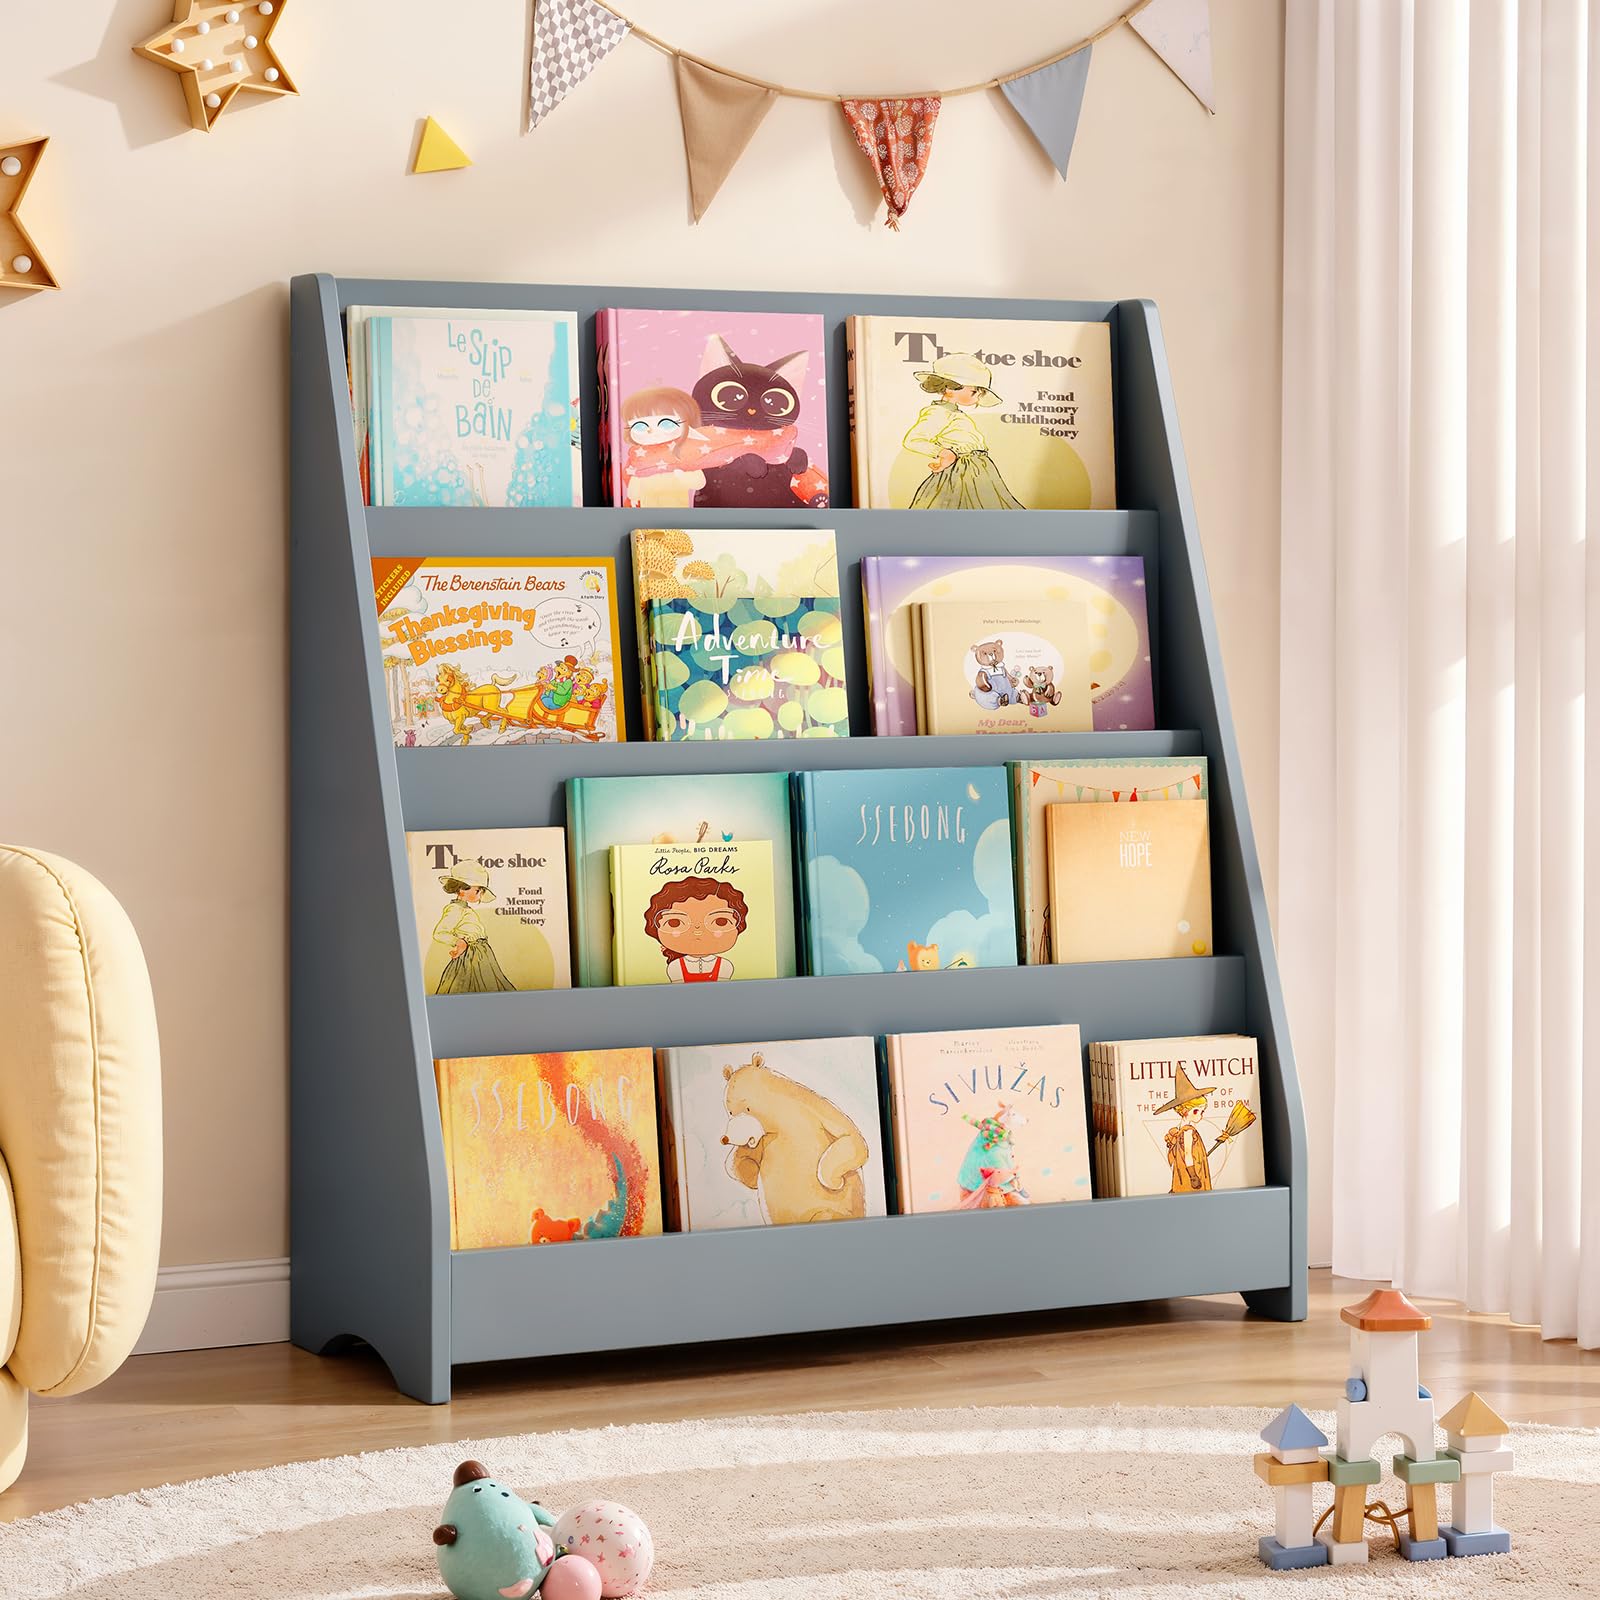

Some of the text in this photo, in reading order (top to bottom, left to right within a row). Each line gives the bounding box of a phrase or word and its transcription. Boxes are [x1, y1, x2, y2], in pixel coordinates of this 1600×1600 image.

[447, 322, 466, 352] Le
[974, 349, 1016, 367] toe
[1021, 350, 1082, 368] shoe
[1037, 391, 1075, 402] Fond
[1018, 403, 1079, 416] Memory
[1000, 414, 1075, 426] Childhood
[1039, 427, 1079, 440] Story
[375, 564, 403, 599] STICKERS
[380, 570, 411, 607] INCLUDED
[420, 574, 566, 591] The Berenstain Bears
[388, 601, 536, 644] Thanksgiving
[671, 610, 831, 652] Adventure
[407, 628, 513, 667] Blessings
[709, 655, 792, 685] Time
[977, 719, 996, 728] My
[856, 803, 966, 845] SSEBONG
[477, 854, 504, 869] toe
[507, 853, 547, 868] shoe
[1120, 842, 1152, 868] HOPE
[649, 855, 740, 875] Rosa Parks
[518, 887, 542, 895] Fond
[506, 897, 546, 906] Memory
[495, 906, 543, 916] Childhood
[520, 916, 546, 926] Story
[1193, 1057, 1254, 1077] WITCH
[929, 1061, 1065, 1115] SIVUŽAS
[1148, 1091, 1169, 1099] THE
[1220, 1088, 1234, 1096] OF
[1137, 1104, 1156, 1112] THE
